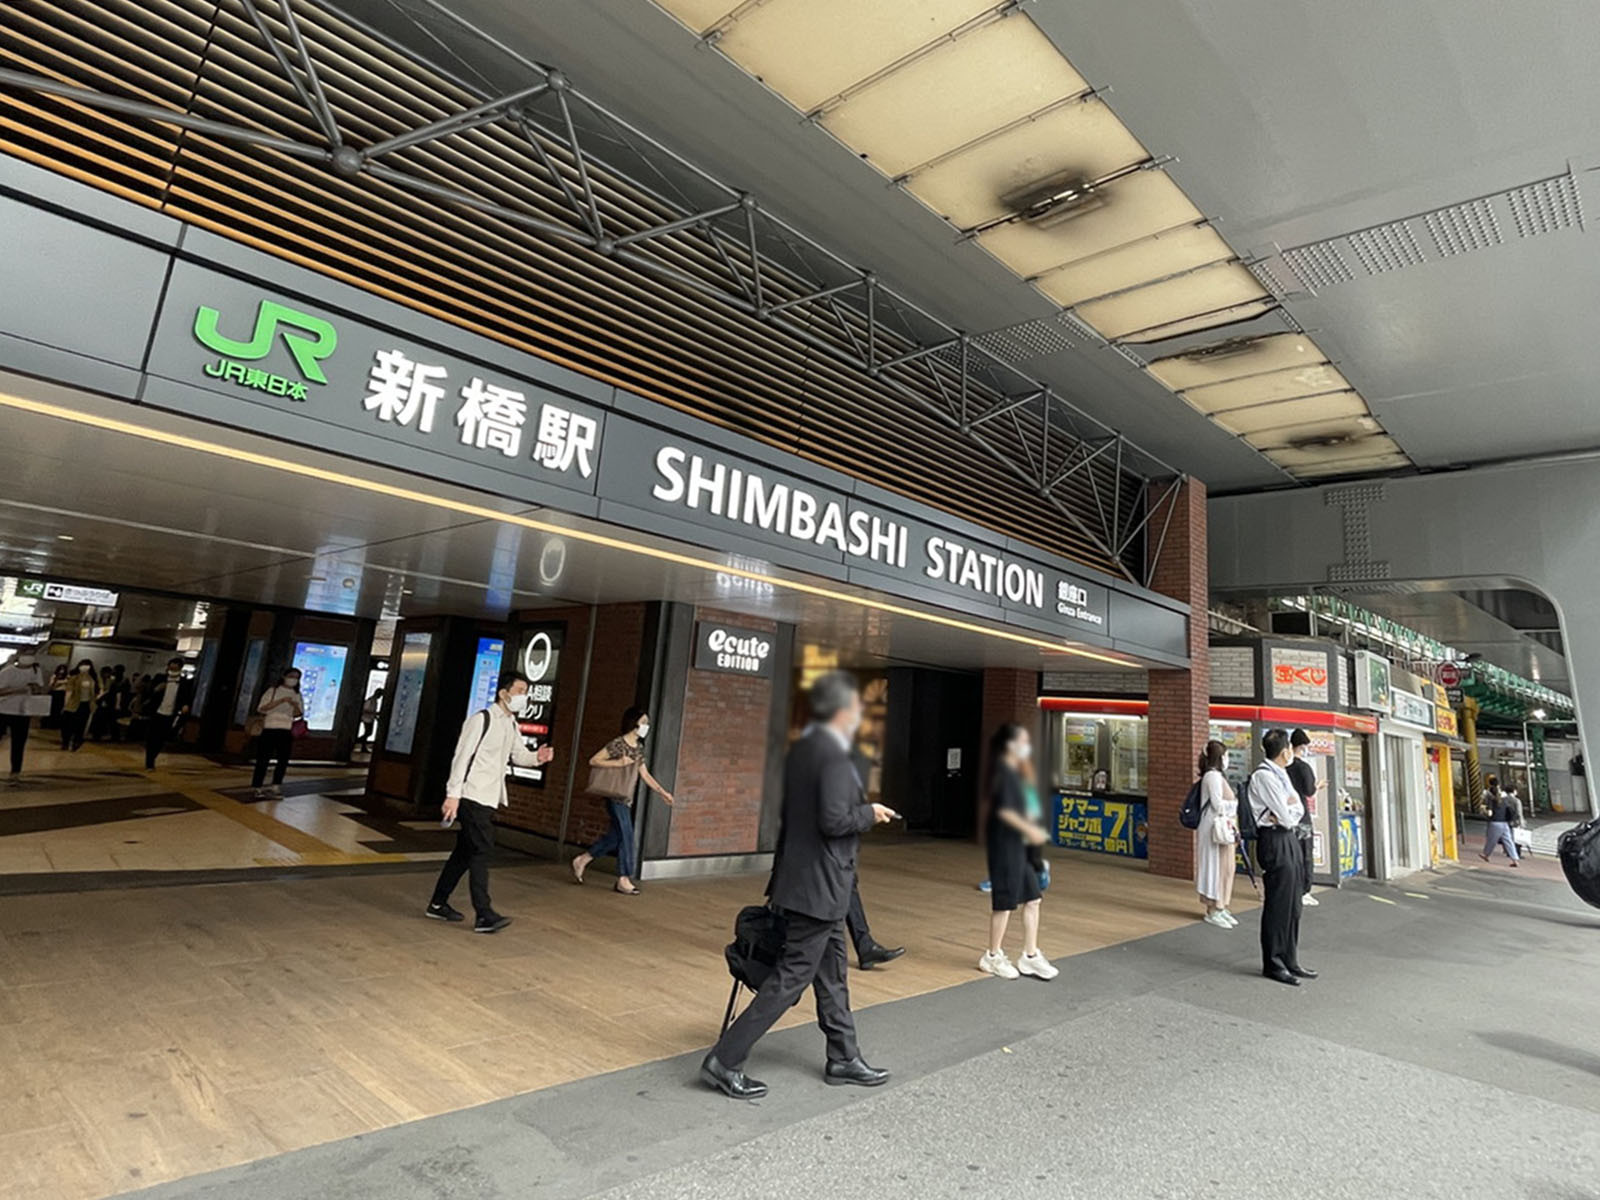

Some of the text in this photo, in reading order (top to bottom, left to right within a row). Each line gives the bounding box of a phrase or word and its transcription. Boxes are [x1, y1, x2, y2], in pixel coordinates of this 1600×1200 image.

[194, 300, 338, 384] JR
[204, 359, 308, 401] JR東日本
[364, 349, 598, 479] 新橋駅
[652, 446, 1044, 608] SHIMBASHI STATION
[23, 583, 44, 593] JR
[1057, 602, 1102, 625] Ginza Entrance
[708, 629, 770, 659] ecute
[717, 652, 760, 672] EDITION
[1274, 664, 1327, 686] 宝くじ
[1062, 797, 1099, 815] サマー
[1058, 814, 1102, 834] ジャンボ
[1104, 801, 1128, 838] 7
